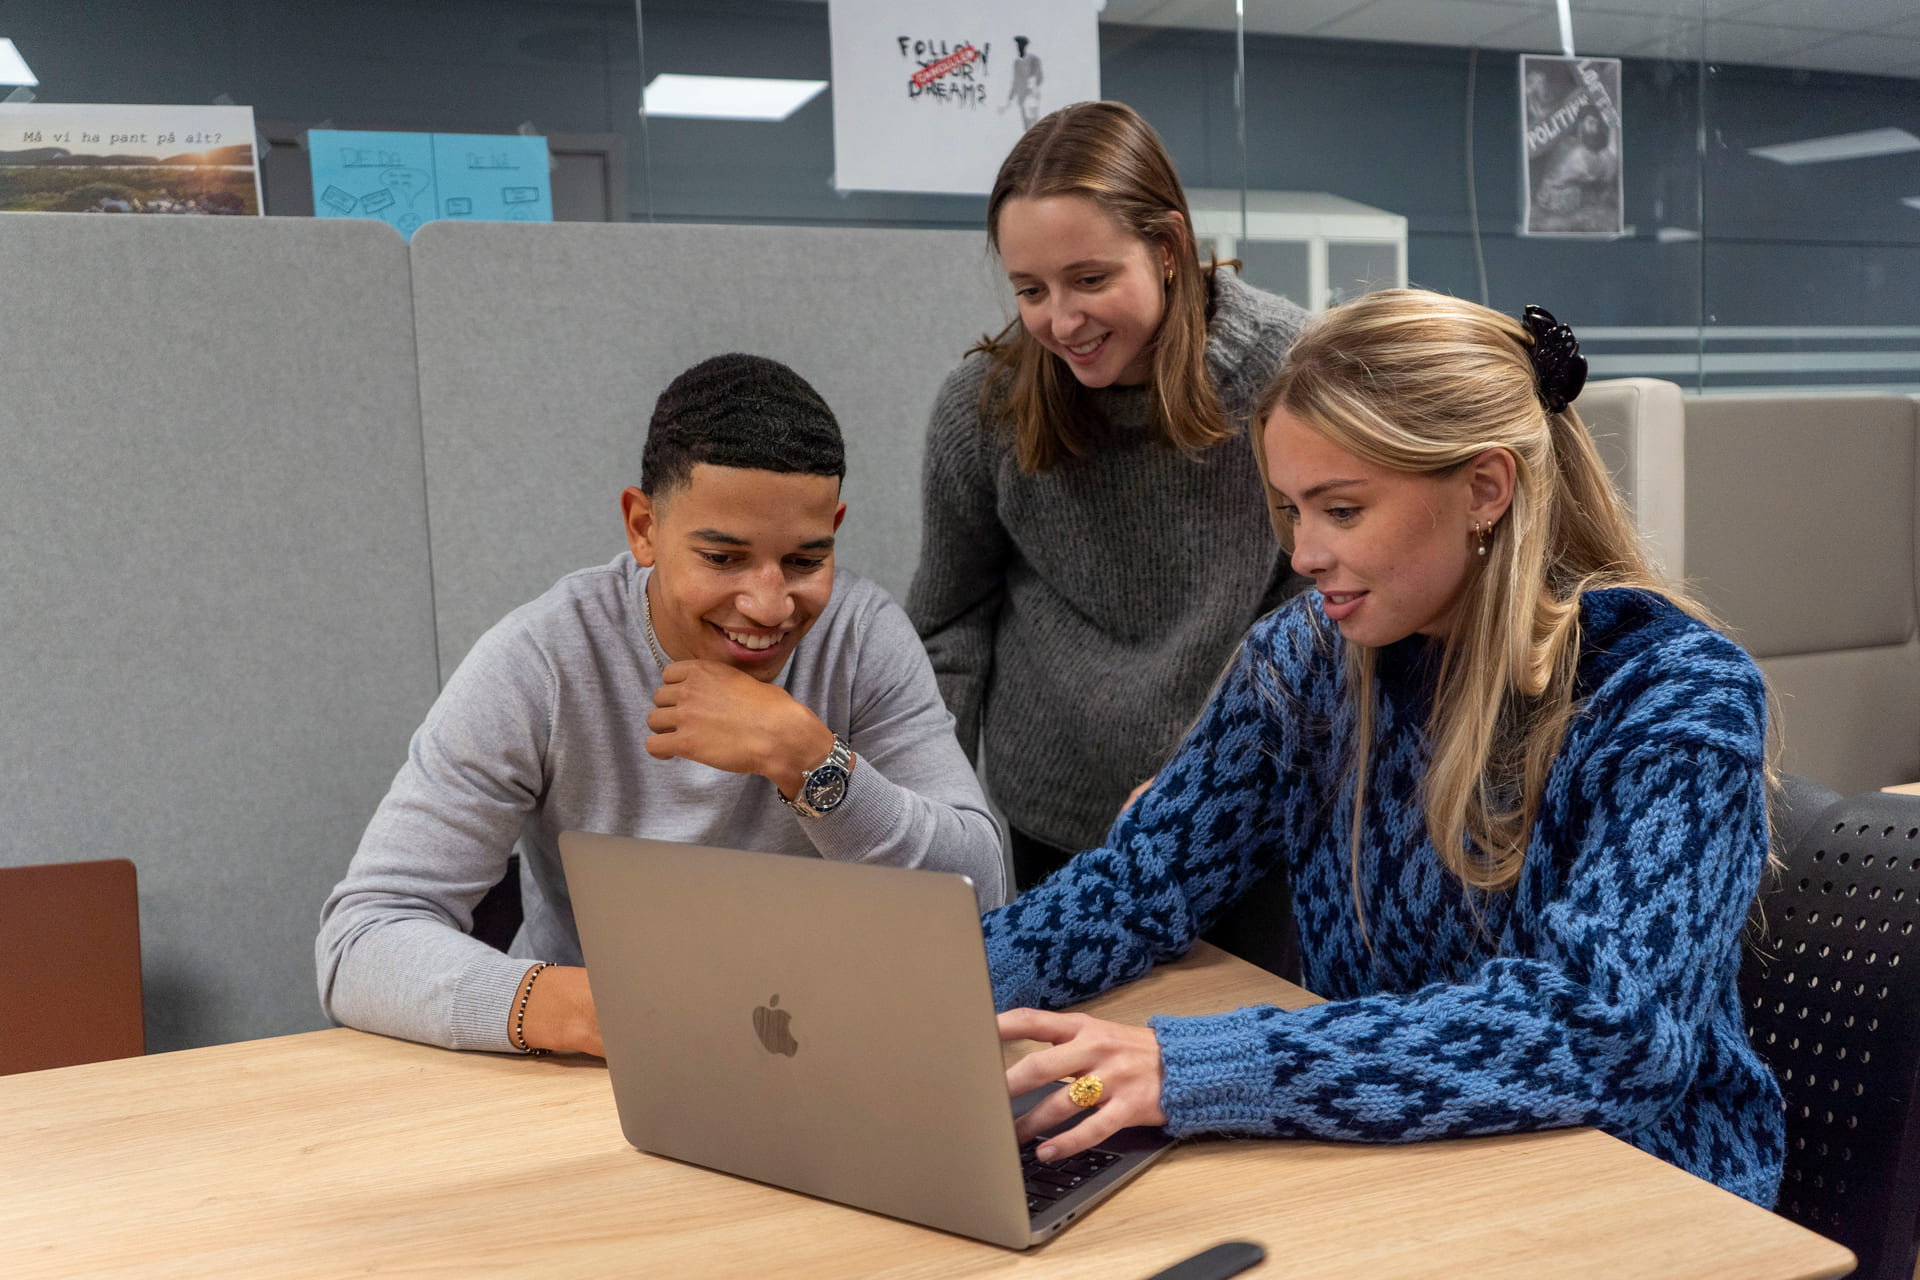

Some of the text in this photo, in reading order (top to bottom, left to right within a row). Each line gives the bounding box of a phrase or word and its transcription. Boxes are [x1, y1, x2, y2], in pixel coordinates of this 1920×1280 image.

[897, 36, 991, 65] FOLLOW
[907, 79, 986, 102] DREAMS
[23, 131, 223, 146] Må vi ha pant på alt?
